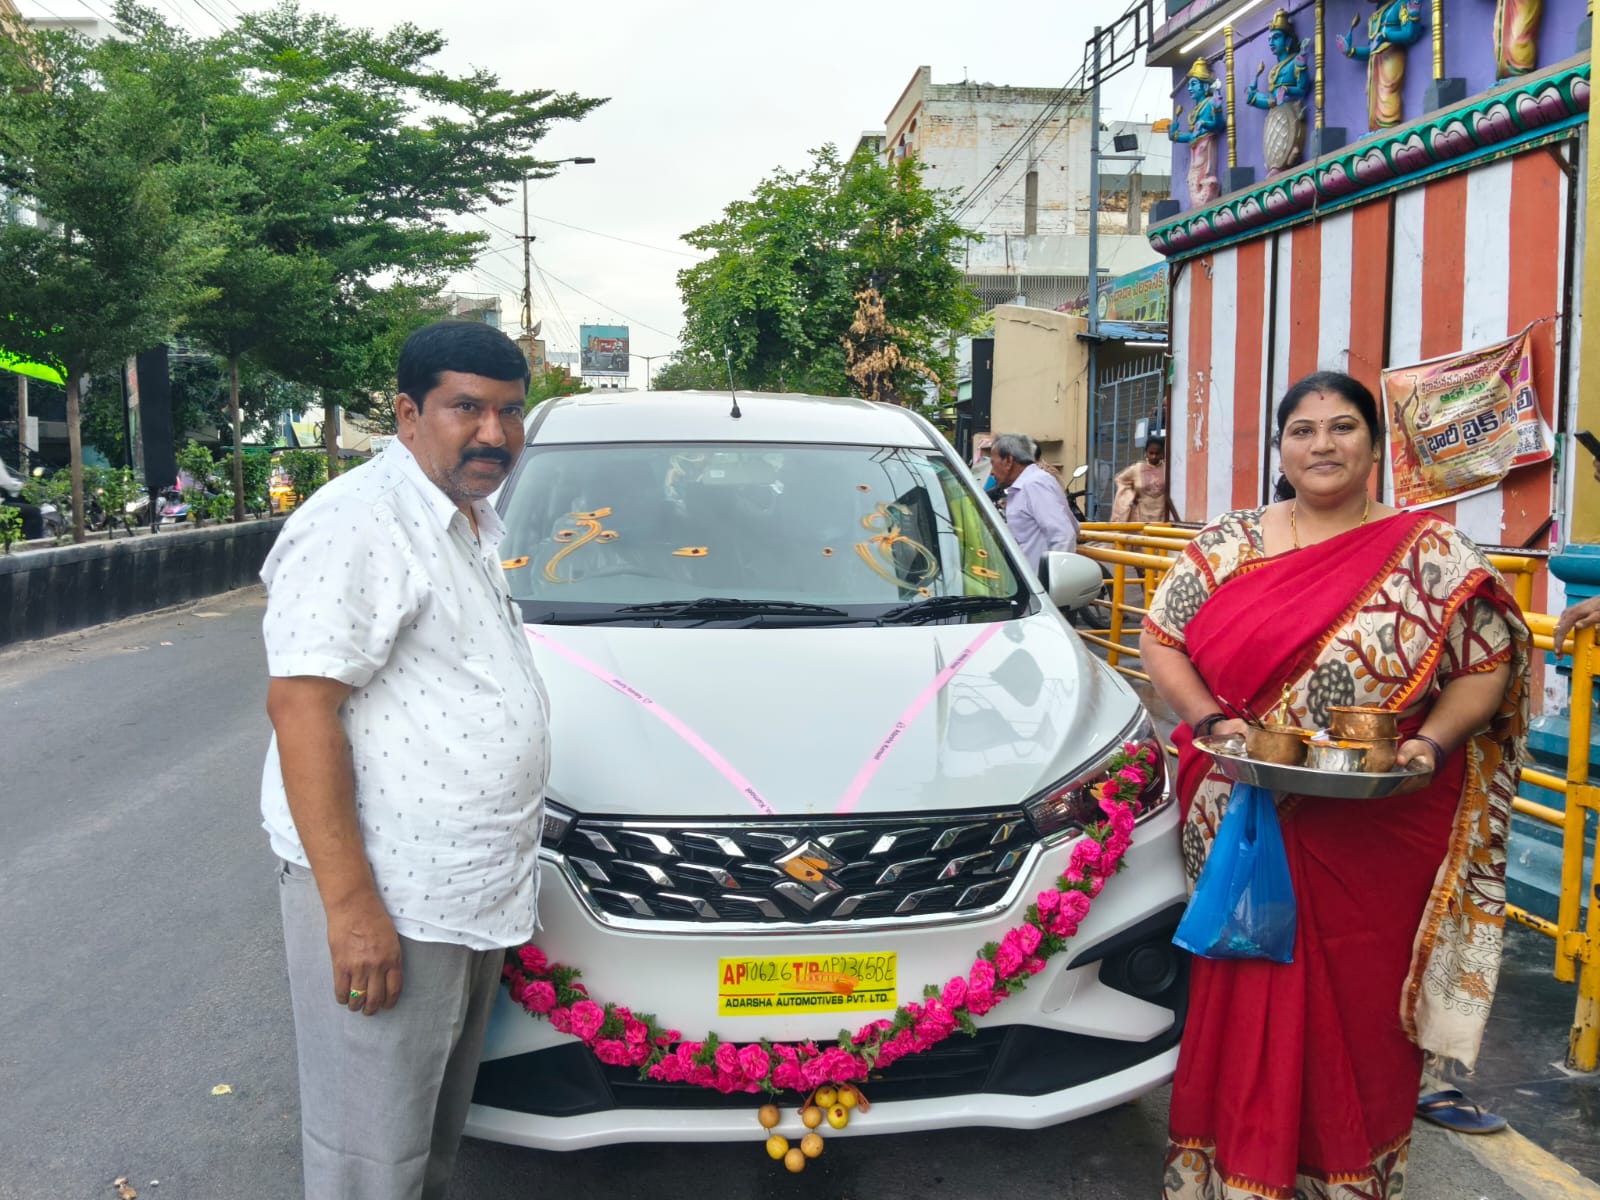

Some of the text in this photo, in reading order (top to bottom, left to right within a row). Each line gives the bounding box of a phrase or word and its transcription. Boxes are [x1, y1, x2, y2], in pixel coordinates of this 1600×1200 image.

[1427, 423, 1460, 454] భారీ
[1463, 411, 1499, 447] బైక్
[725, 993, 889, 1008] ADARSHA AUTOMOTIVES PVT. LTD.
